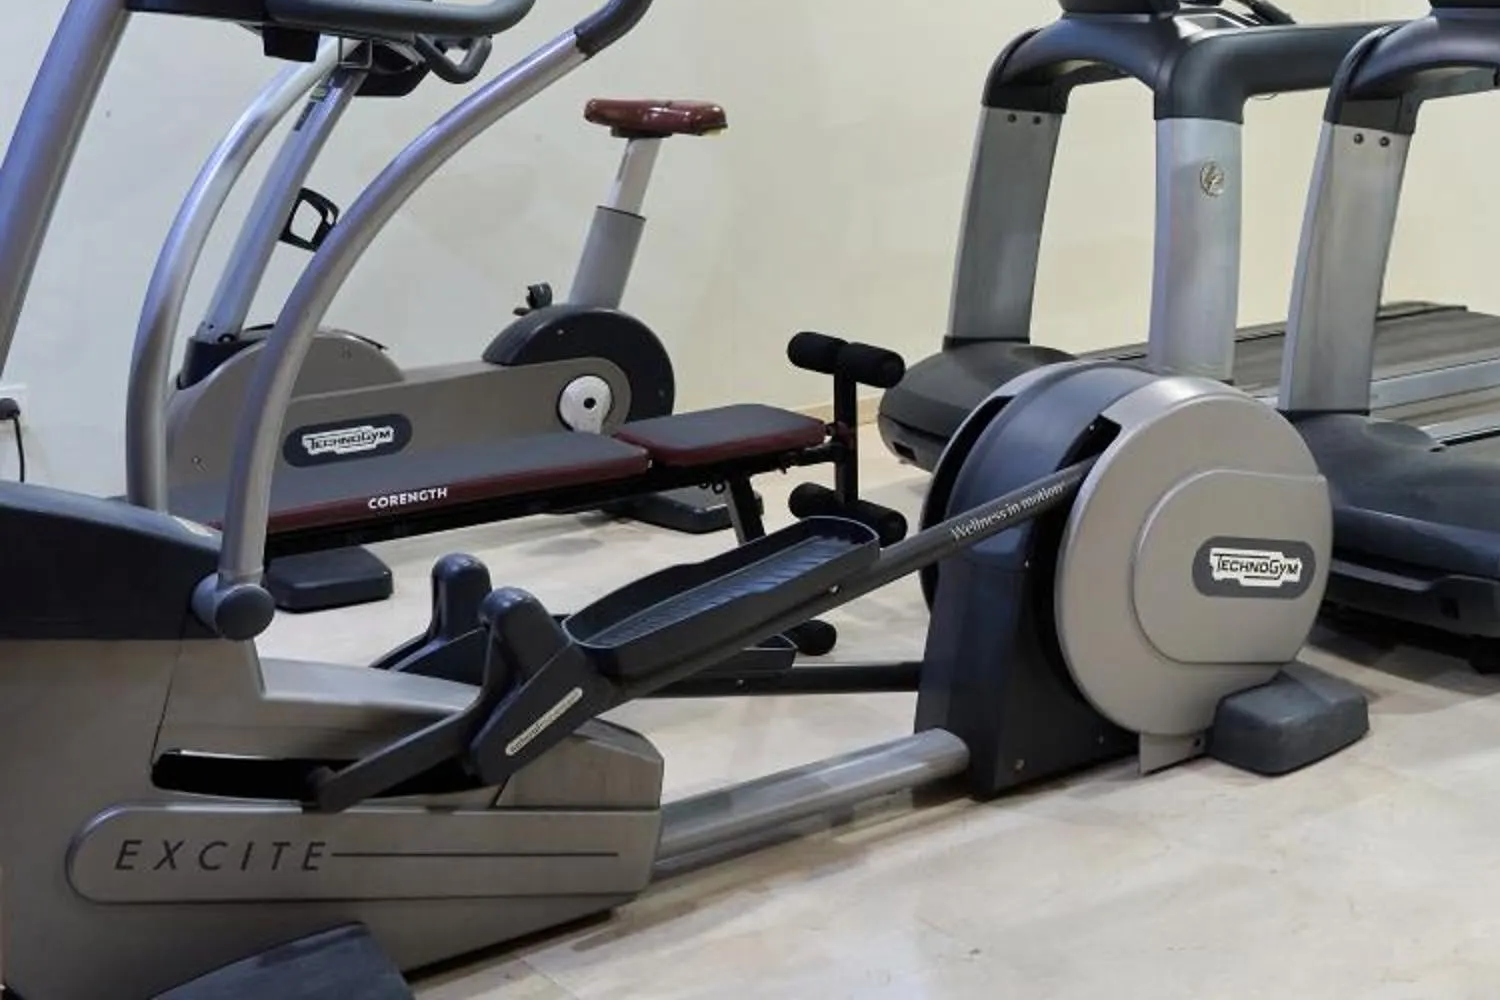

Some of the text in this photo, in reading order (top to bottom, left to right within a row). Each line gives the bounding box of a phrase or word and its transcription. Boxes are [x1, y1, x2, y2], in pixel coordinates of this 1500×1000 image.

[367, 487, 448, 510] CORENGTH
[950, 481, 1066, 541] Wellness in motion
[1211, 552, 1300, 581] TECHNOGYM
[114, 839, 326, 871] EXCITE
